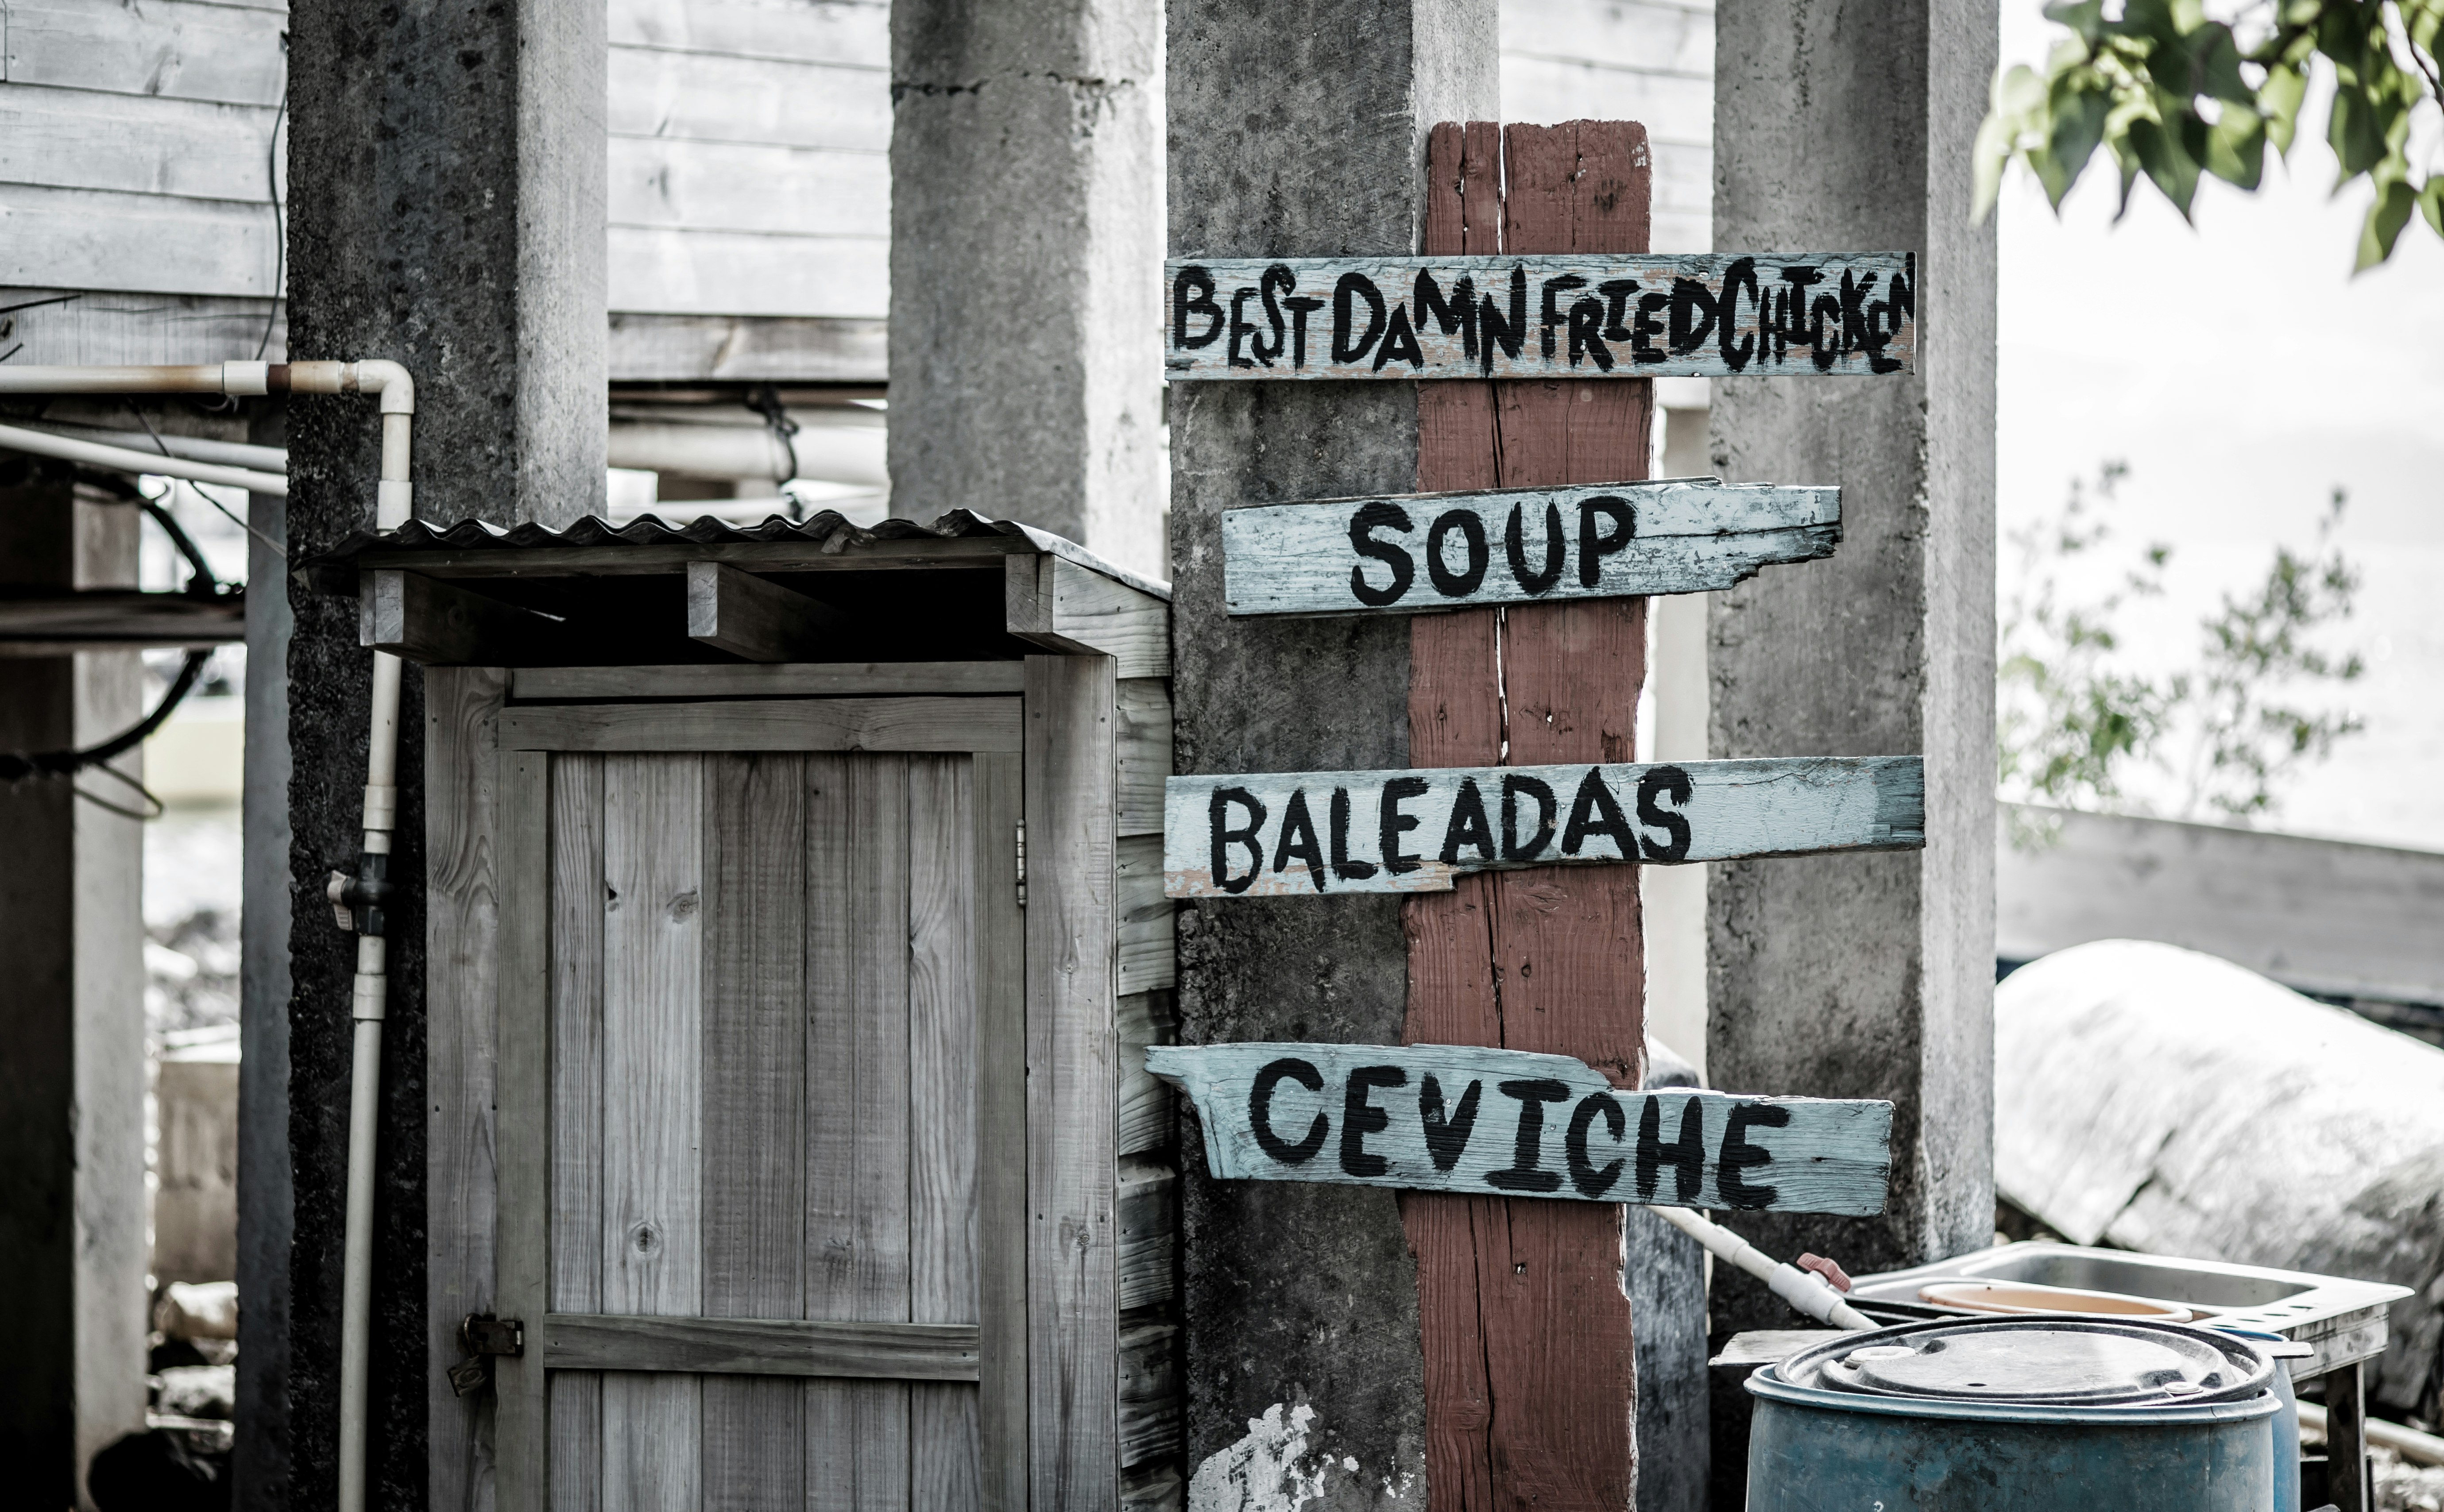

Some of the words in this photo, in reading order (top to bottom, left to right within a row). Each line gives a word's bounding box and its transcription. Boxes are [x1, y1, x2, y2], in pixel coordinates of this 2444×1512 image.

[1173, 263, 1326, 375] BEST
[1331, 262, 1528, 378] DAMN
[1540, 272, 1720, 373] FRIED
[1349, 495, 1637, 606] SOUP
[1209, 765, 1693, 893] BALEADAS
[1249, 1057, 1790, 1210] CEVICHE
